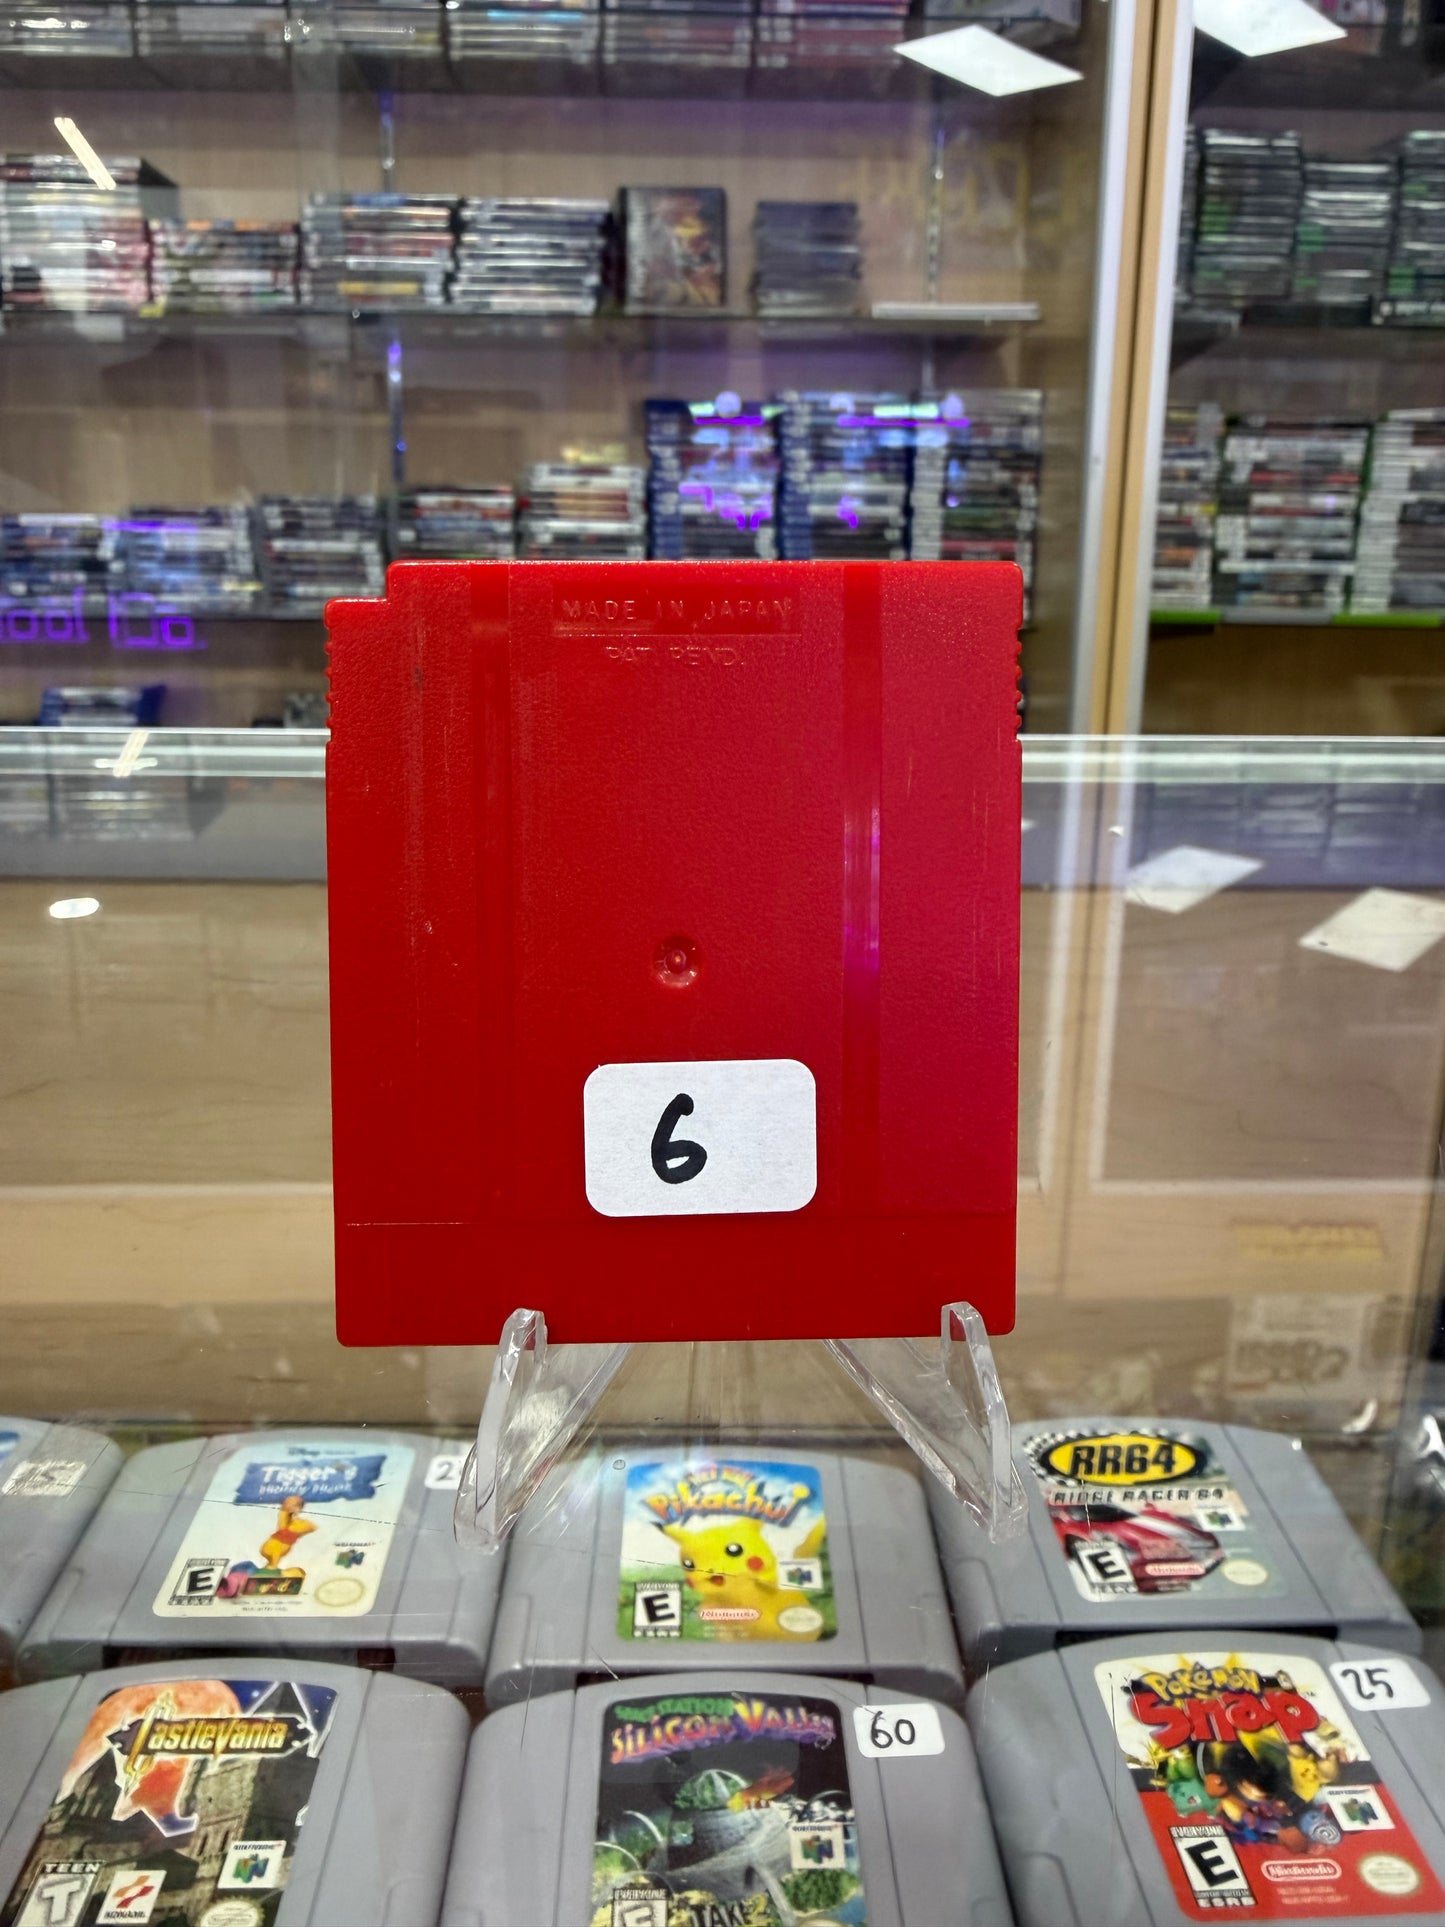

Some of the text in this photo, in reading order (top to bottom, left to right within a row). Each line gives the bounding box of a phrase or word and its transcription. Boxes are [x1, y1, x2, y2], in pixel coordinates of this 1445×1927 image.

[562, 598, 792, 620] MADE IN JAPAN
[651, 1093, 708, 1185] 6
[436, 1461, 460, 1482] 2
[1070, 1443, 1177, 1478] RR64
[644, 1481, 811, 1523] Pikachu!
[1122, 1488, 1191, 1502] RACER
[187, 1567, 215, 1594] E
[1087, 1550, 1127, 1579] E
[642, 1593, 676, 1623] E
[1342, 1668, 1395, 1700] 25
[871, 1710, 916, 1749] 60
[1130, 1690, 1321, 1751] Snap
[44, 1863, 101, 1874] TEEN
[1184, 1840, 1240, 1888] E
[42, 1880, 82, 1923] T
